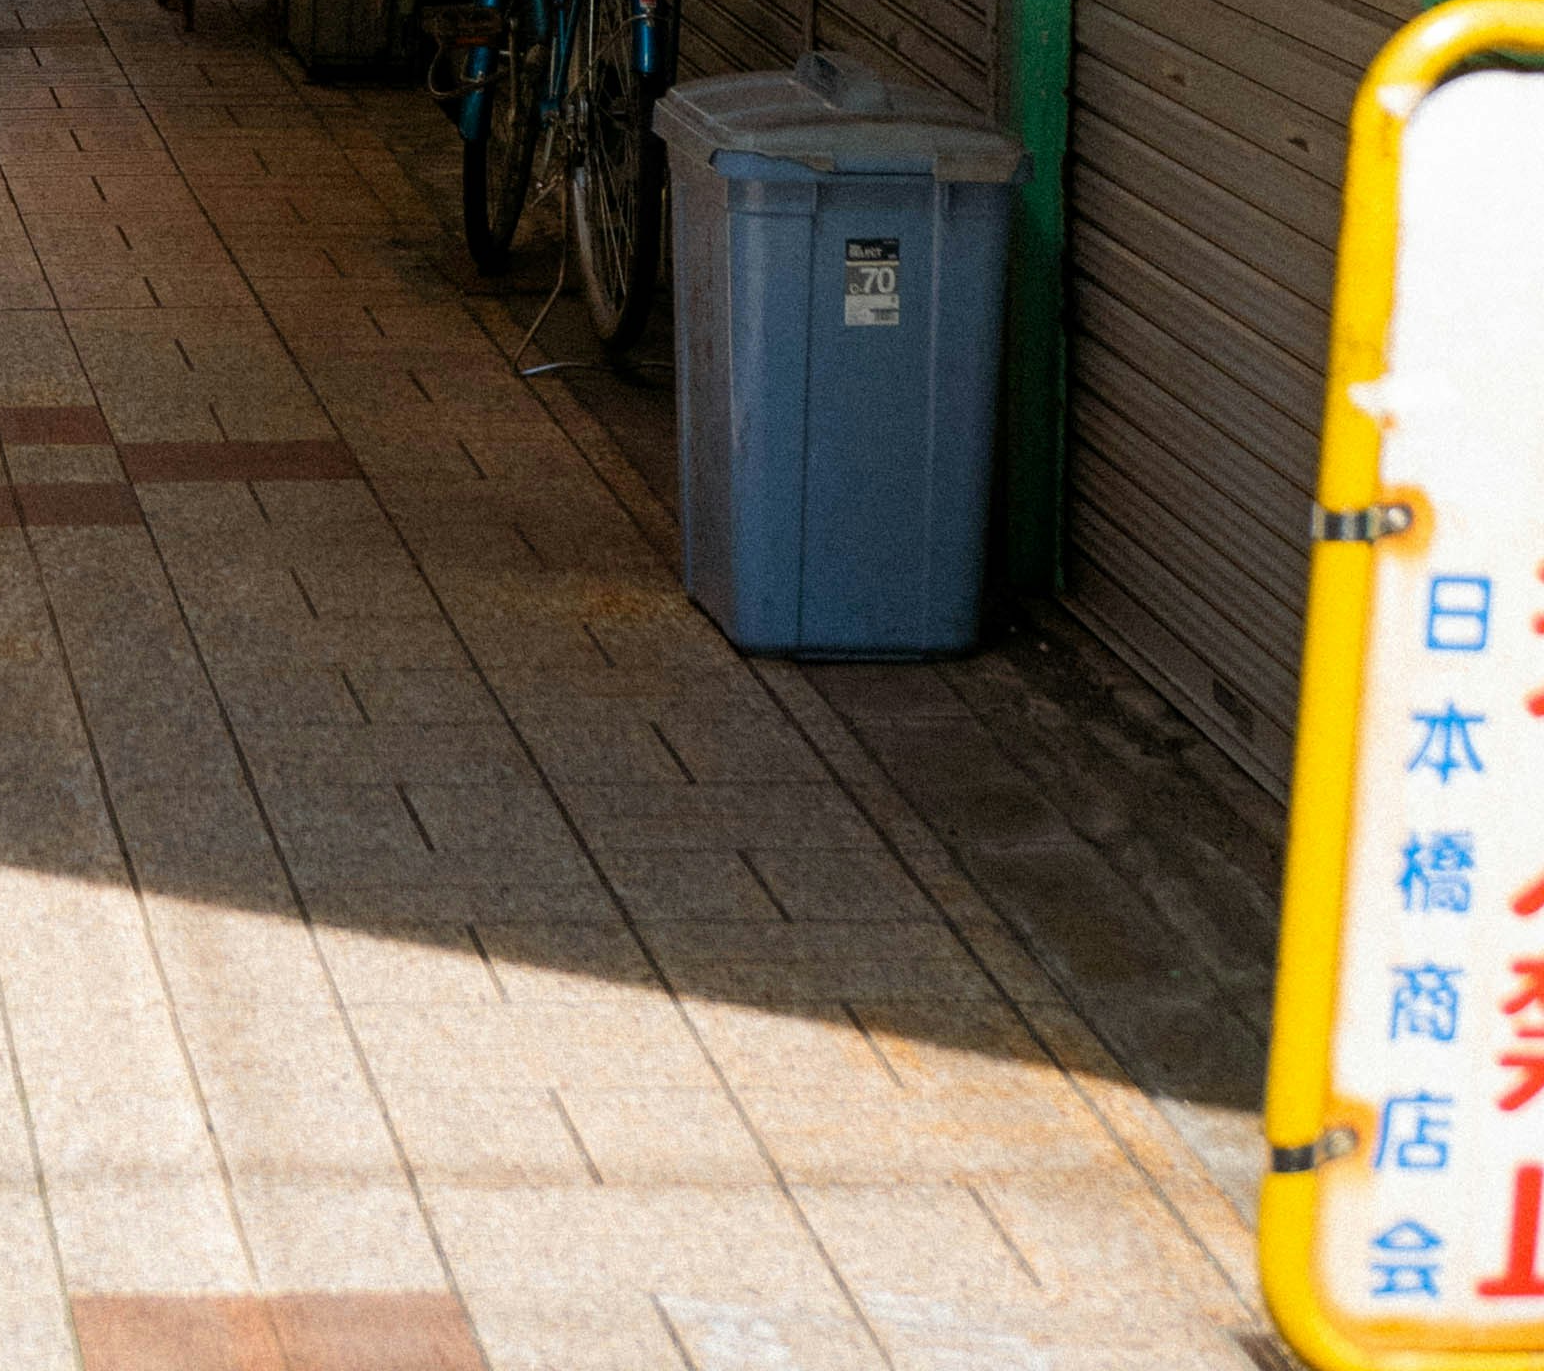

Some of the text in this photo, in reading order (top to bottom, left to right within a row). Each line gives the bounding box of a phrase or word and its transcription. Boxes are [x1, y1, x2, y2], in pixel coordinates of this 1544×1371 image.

[1370, 574, 1492, 1300] 日本橋商店会
